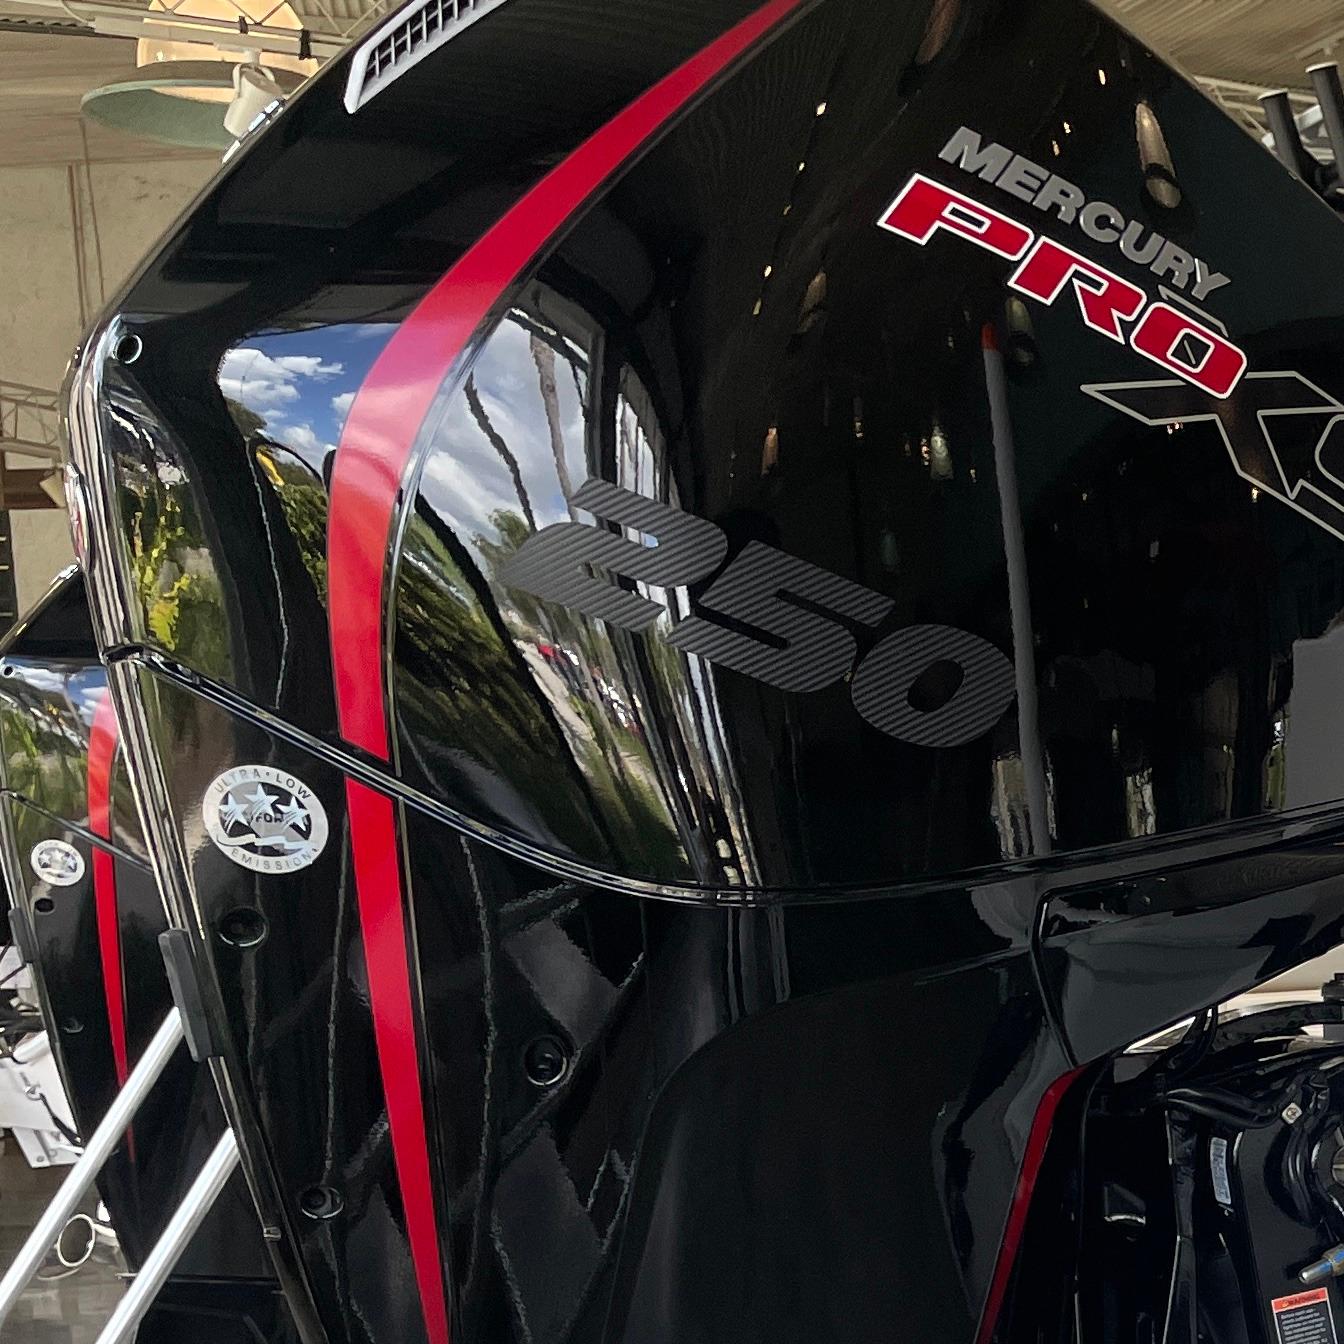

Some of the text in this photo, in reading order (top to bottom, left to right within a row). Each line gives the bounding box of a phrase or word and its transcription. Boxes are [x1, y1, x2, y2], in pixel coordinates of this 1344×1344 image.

[876, 172, 1248, 398] PRO
[938, 126, 1230, 301] MERCURY
[502, 477, 1016, 748] 250
[214, 768, 312, 800] ULTRA LOW
[231, 847, 313, 870] EMISSION
